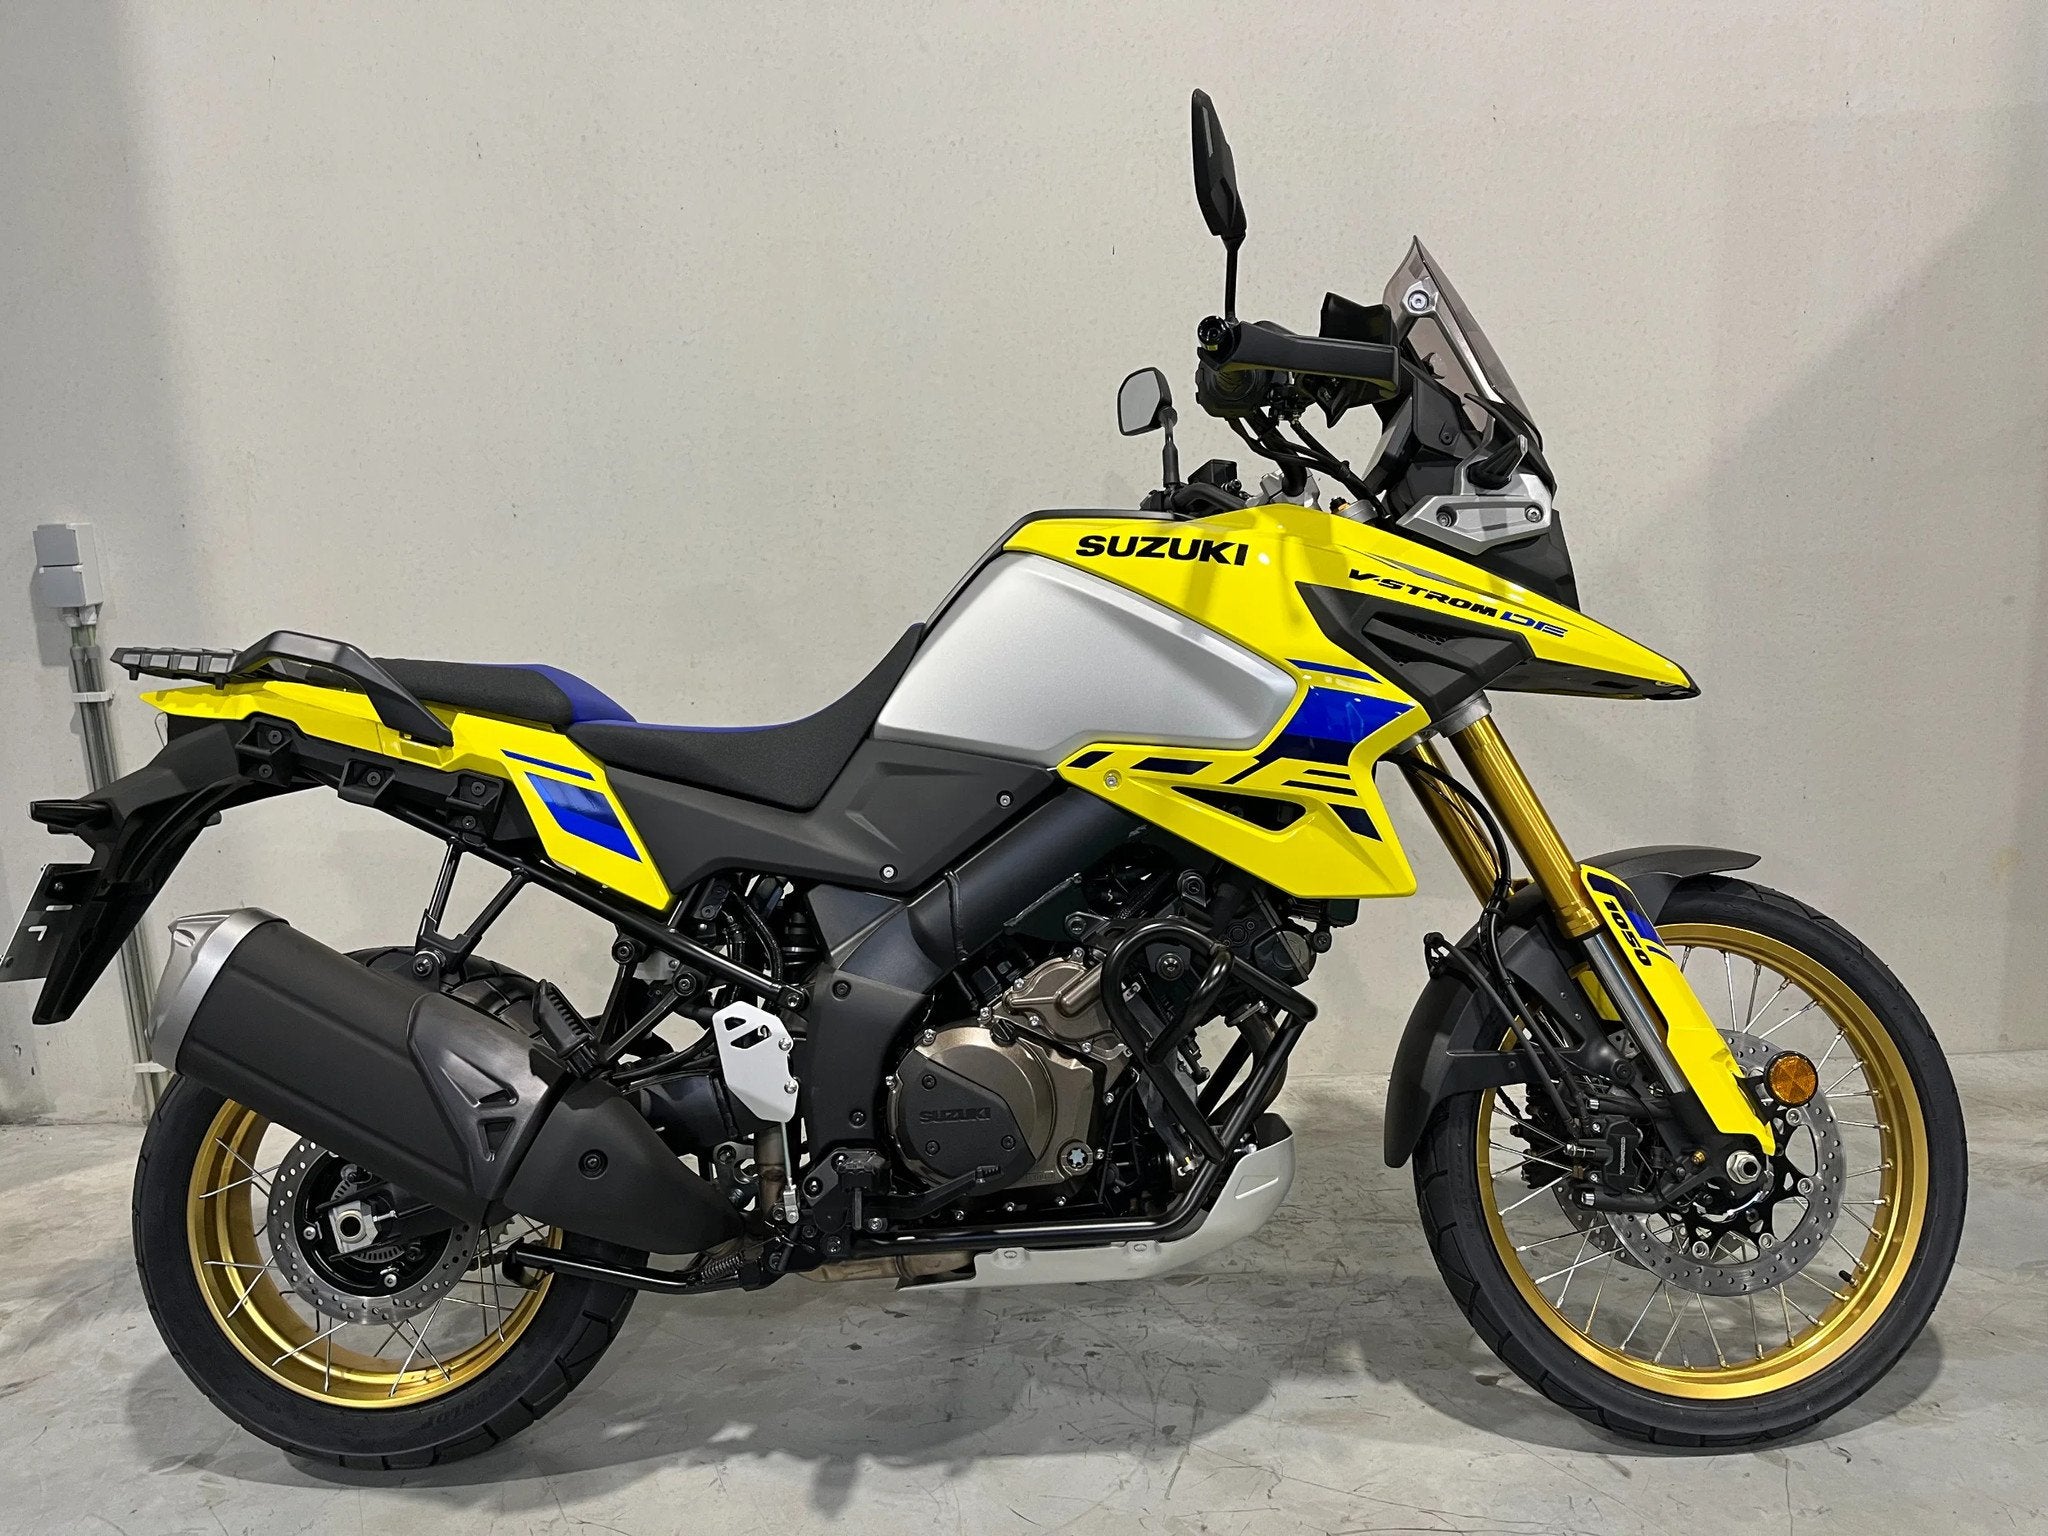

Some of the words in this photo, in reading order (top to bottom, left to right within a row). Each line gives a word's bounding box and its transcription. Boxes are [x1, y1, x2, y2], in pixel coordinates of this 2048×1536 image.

[1076, 535, 1249, 566] SUZUKI
[1348, 568, 1498, 618] V-STROM
[1499, 611, 1569, 639] DE
[1603, 899, 1653, 967] 1050
[919, 1106, 992, 1124] SUZUKI
